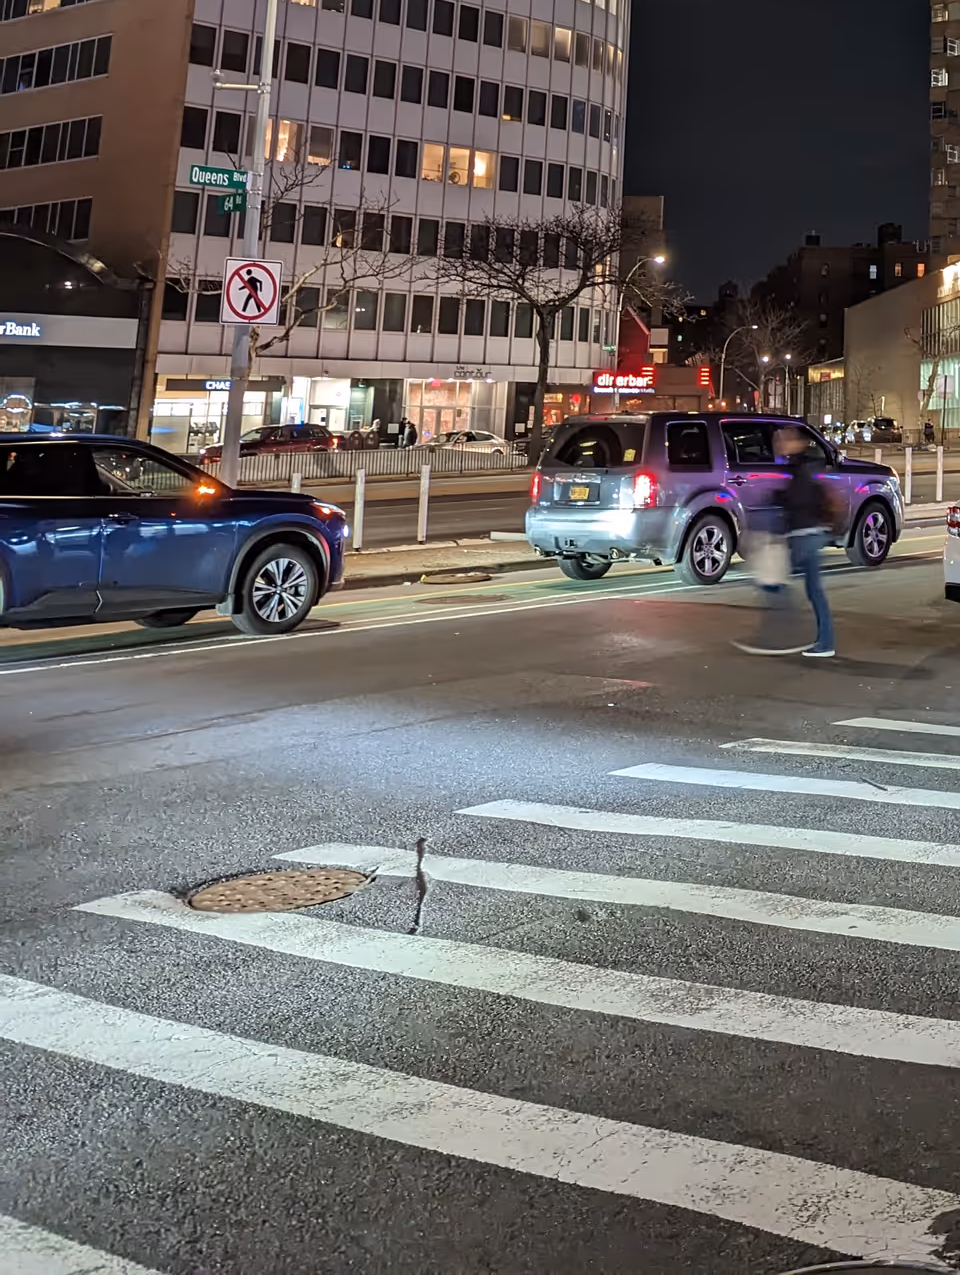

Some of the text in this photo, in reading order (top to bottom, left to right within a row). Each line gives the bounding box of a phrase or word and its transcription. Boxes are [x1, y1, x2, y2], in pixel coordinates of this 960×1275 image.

[192, 167, 247, 185] Queens Blvd
[224, 196, 234, 211] 64
[0, 321, 41, 337] rBank
